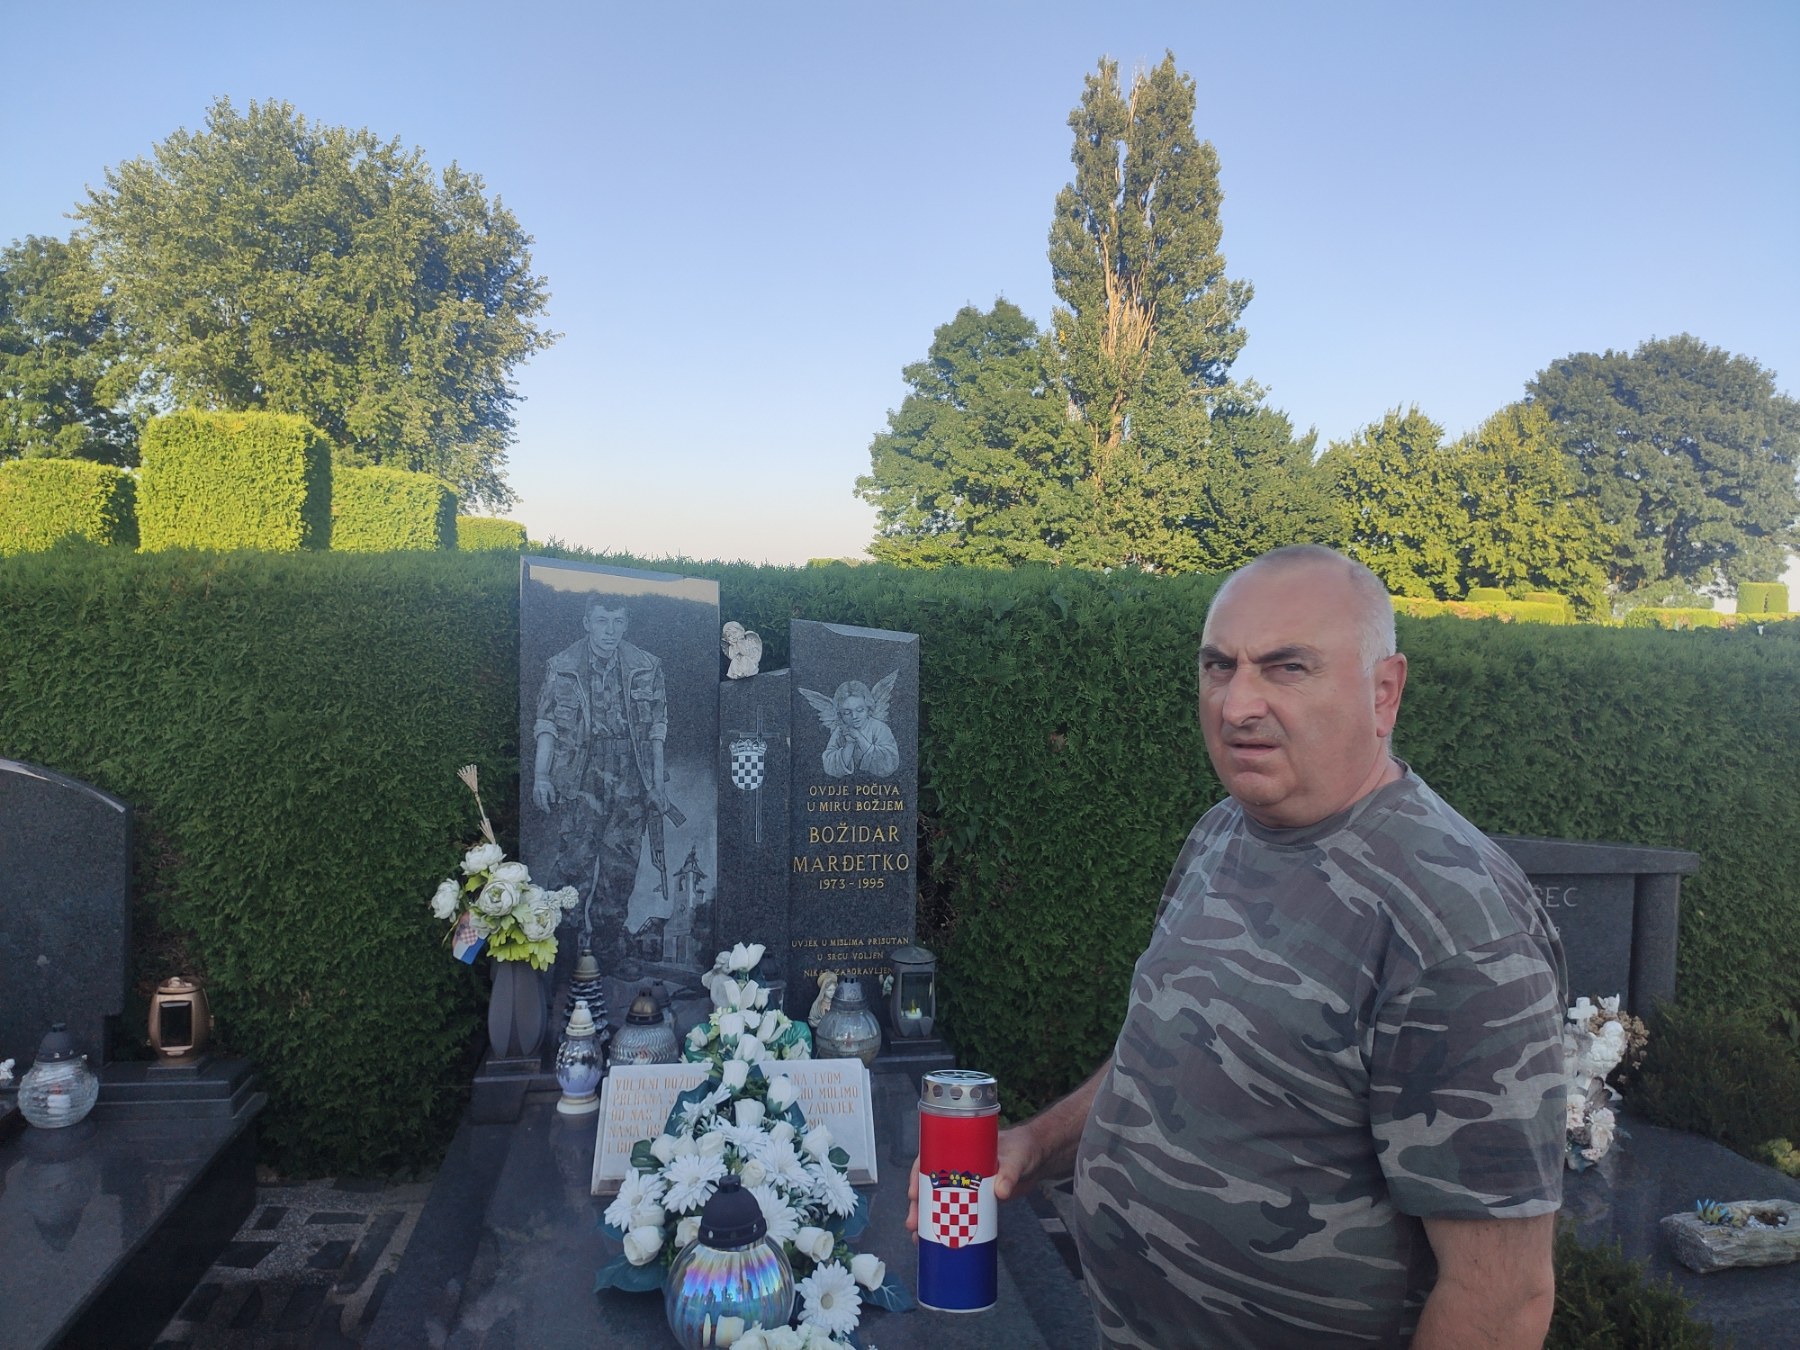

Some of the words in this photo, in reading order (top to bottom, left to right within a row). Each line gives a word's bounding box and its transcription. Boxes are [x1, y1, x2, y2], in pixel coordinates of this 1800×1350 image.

[809, 785, 849, 796] OVDJE
[856, 783, 900, 796] POČIVA
[807, 801, 816, 812] U
[819, 801, 851, 812] MIRU
[856, 799, 904, 811] BOŽJEM
[809, 822, 900, 843] BOŽIDAR
[793, 853, 910, 873] MARĐETKO
[819, 879, 846, 890] 1973
[858, 878, 885, 889] 1995
[821, 939, 827, 947] U
[830, 938, 864, 947] MISLIMA
[868, 937, 909, 945] PRISUTAN
[817, 953, 823, 961] U
[827, 952, 848, 961] SRCU
[852, 951, 884, 960] VOLJEN
[813, 1072, 842, 1085] TVOM
[819, 1086, 859, 1100] MOLIMO
[631, 1107, 652, 1121] NAS
[609, 1124, 640, 1138] NAMA
